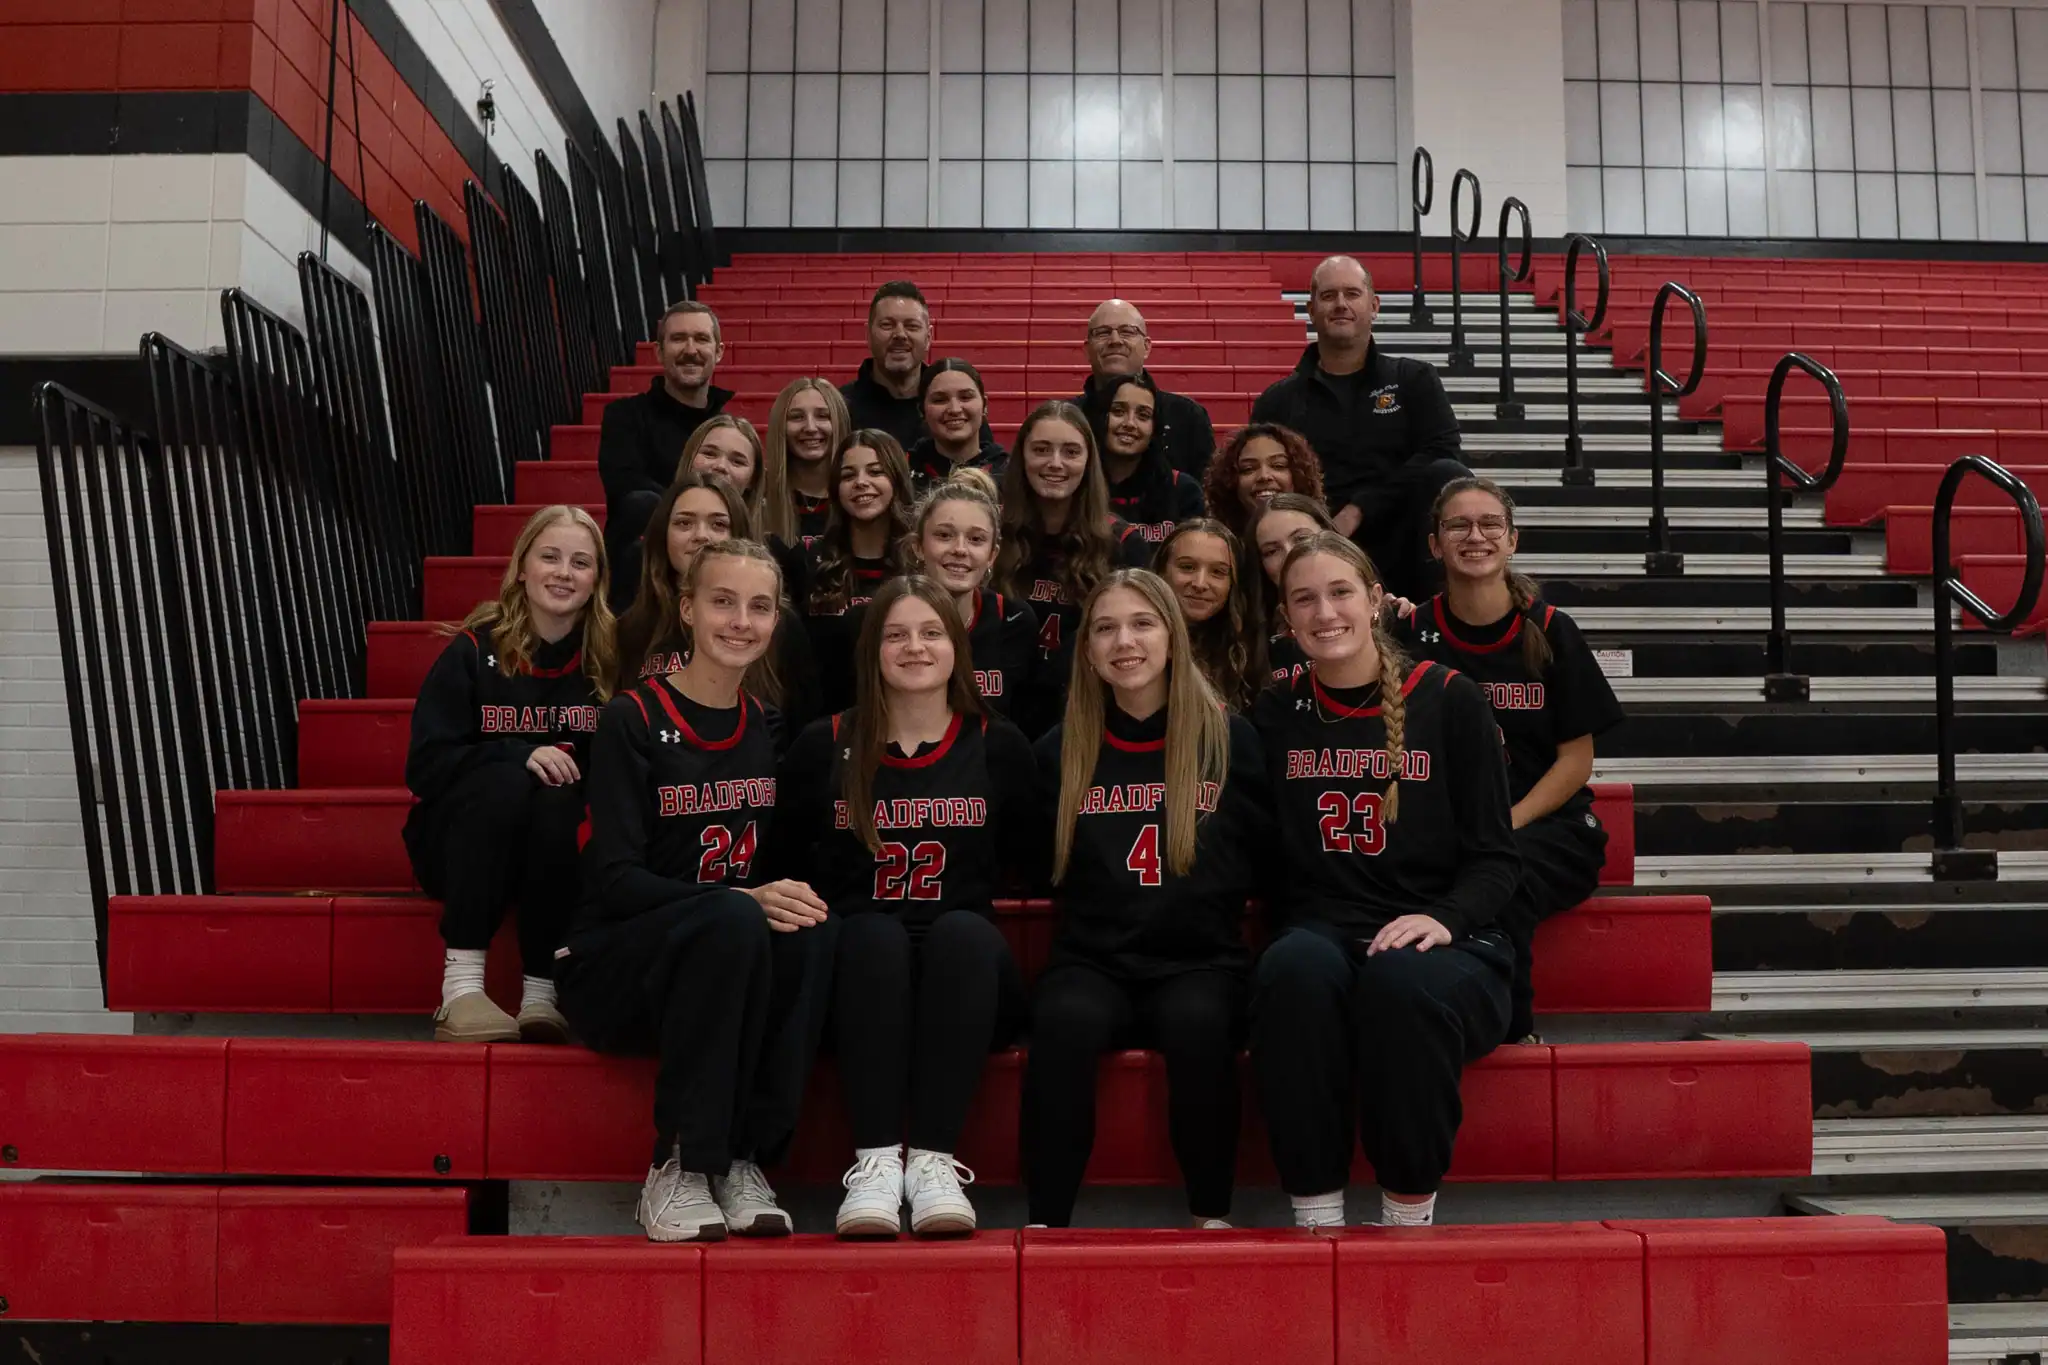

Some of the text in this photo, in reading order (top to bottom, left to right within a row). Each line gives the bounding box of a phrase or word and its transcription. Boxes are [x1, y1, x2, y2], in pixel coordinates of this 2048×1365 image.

[480, 705, 607, 733] BRADFOR
[657, 777, 777, 817] BRADFOR
[834, 797, 987, 830] BADFORD
[1078, 781, 1220, 814] RADFD
[1317, 791, 1387, 856] 23
[697, 819, 757, 884] 24
[872, 841, 946, 901] 22
[1126, 824, 1162, 886] 4
